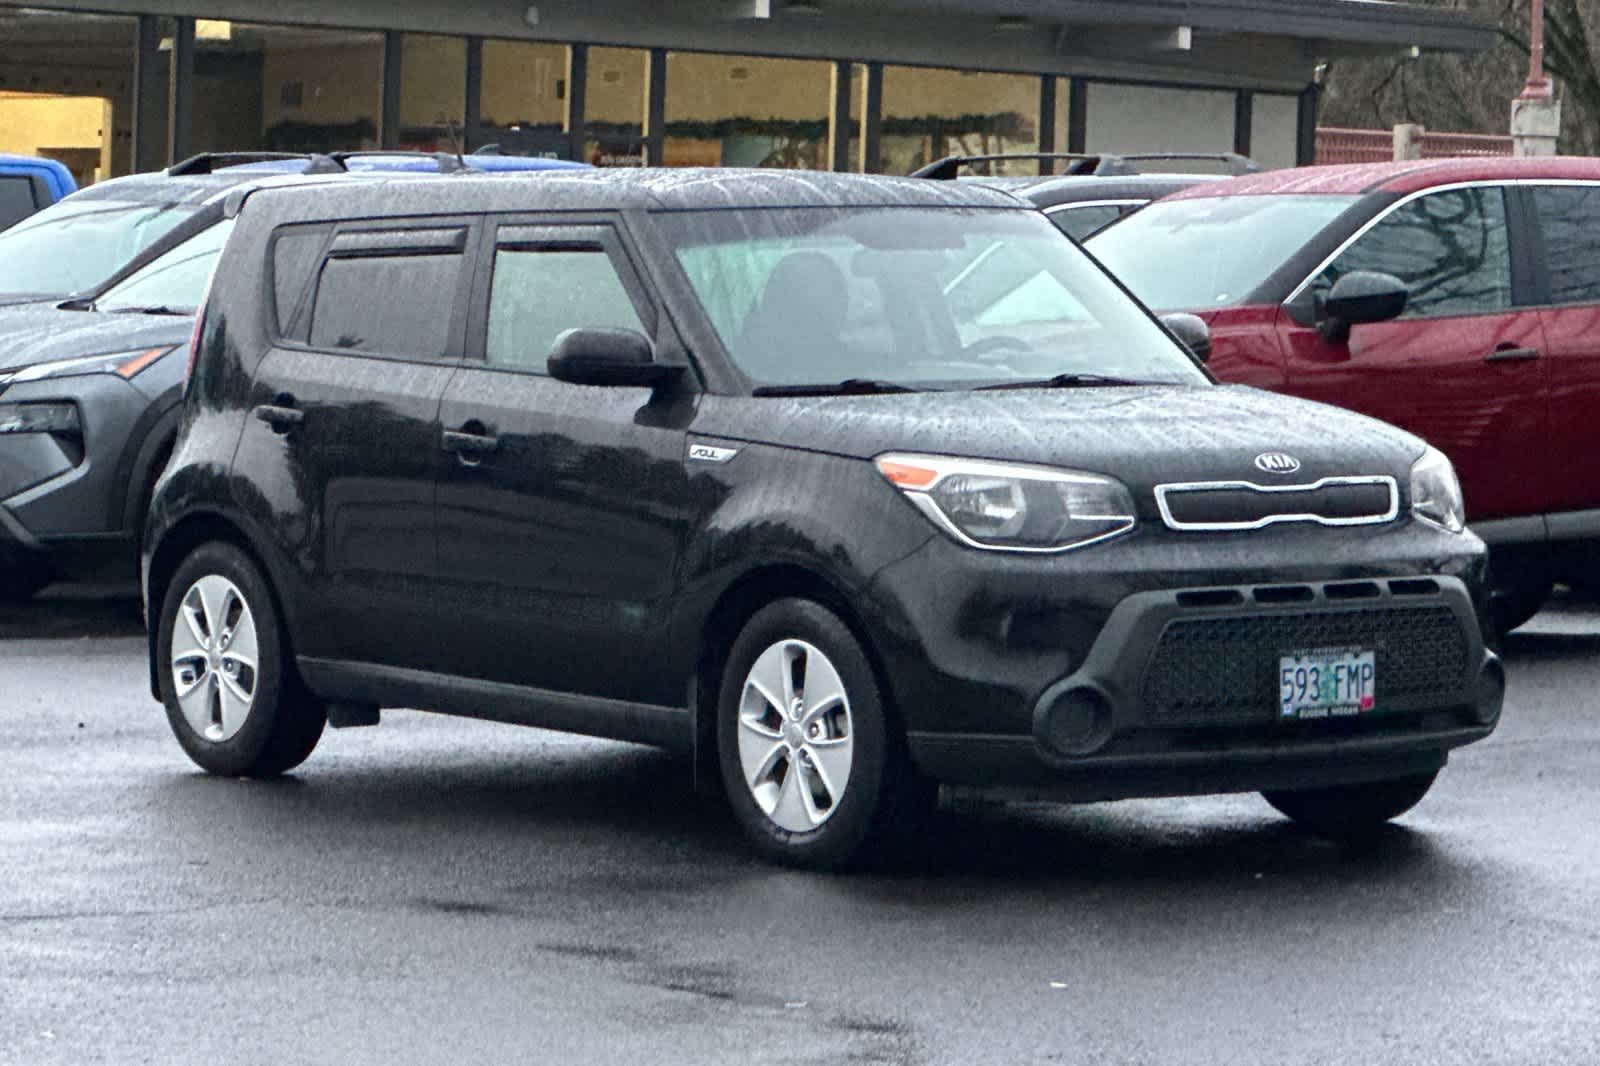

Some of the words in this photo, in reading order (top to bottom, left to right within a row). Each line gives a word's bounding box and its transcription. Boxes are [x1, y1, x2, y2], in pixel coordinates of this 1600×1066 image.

[1260, 454, 1297, 469] KIA
[1281, 667, 1320, 703] 593
[1334, 663, 1373, 700] FMP
